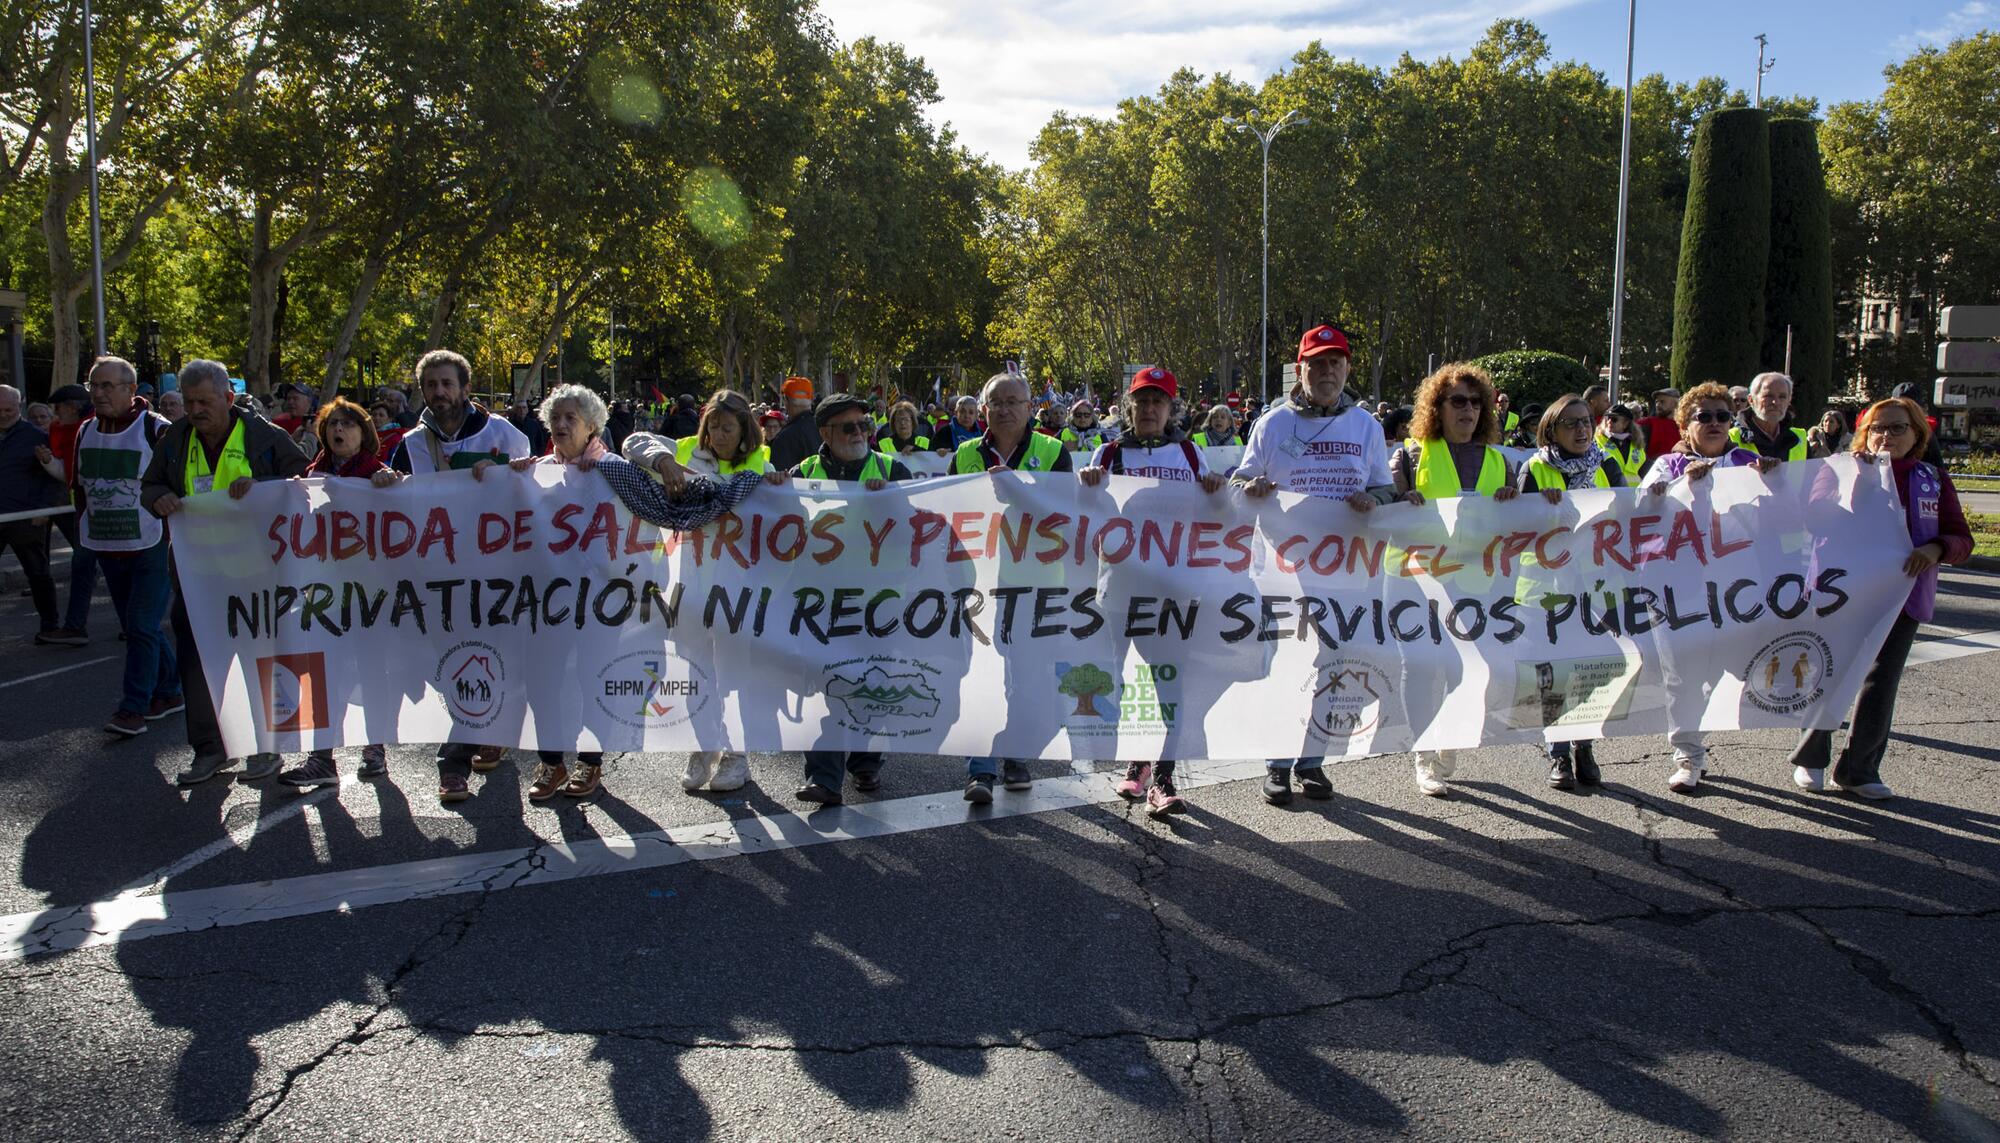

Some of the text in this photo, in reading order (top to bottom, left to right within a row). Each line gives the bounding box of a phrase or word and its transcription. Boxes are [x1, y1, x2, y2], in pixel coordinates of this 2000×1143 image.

[1304, 441, 1361, 456] SJUBI40
[1290, 477, 1307, 486] SIN
[268, 502, 1754, 578] SUBIDA DE SALARIOS Y PENSIONES CON EL IPC REAL
[703, 584, 772, 637] NI
[789, 586, 1105, 645] RECORTES
[1125, 596, 1199, 640] EN
[1219, 593, 1526, 650] SERVICIOS
[1540, 568, 1849, 644] PÚBLICOS
[911, 659, 942, 675] Defensa
[1134, 664, 1177, 682] MO
[1573, 662, 1629, 670] Plataforma
[605, 680, 698, 696] EHPM MPEH
[1120, 683, 1156, 701] DE
[1328, 696, 1364, 704] UNIDAD
[1120, 703, 1178, 721] PEN
